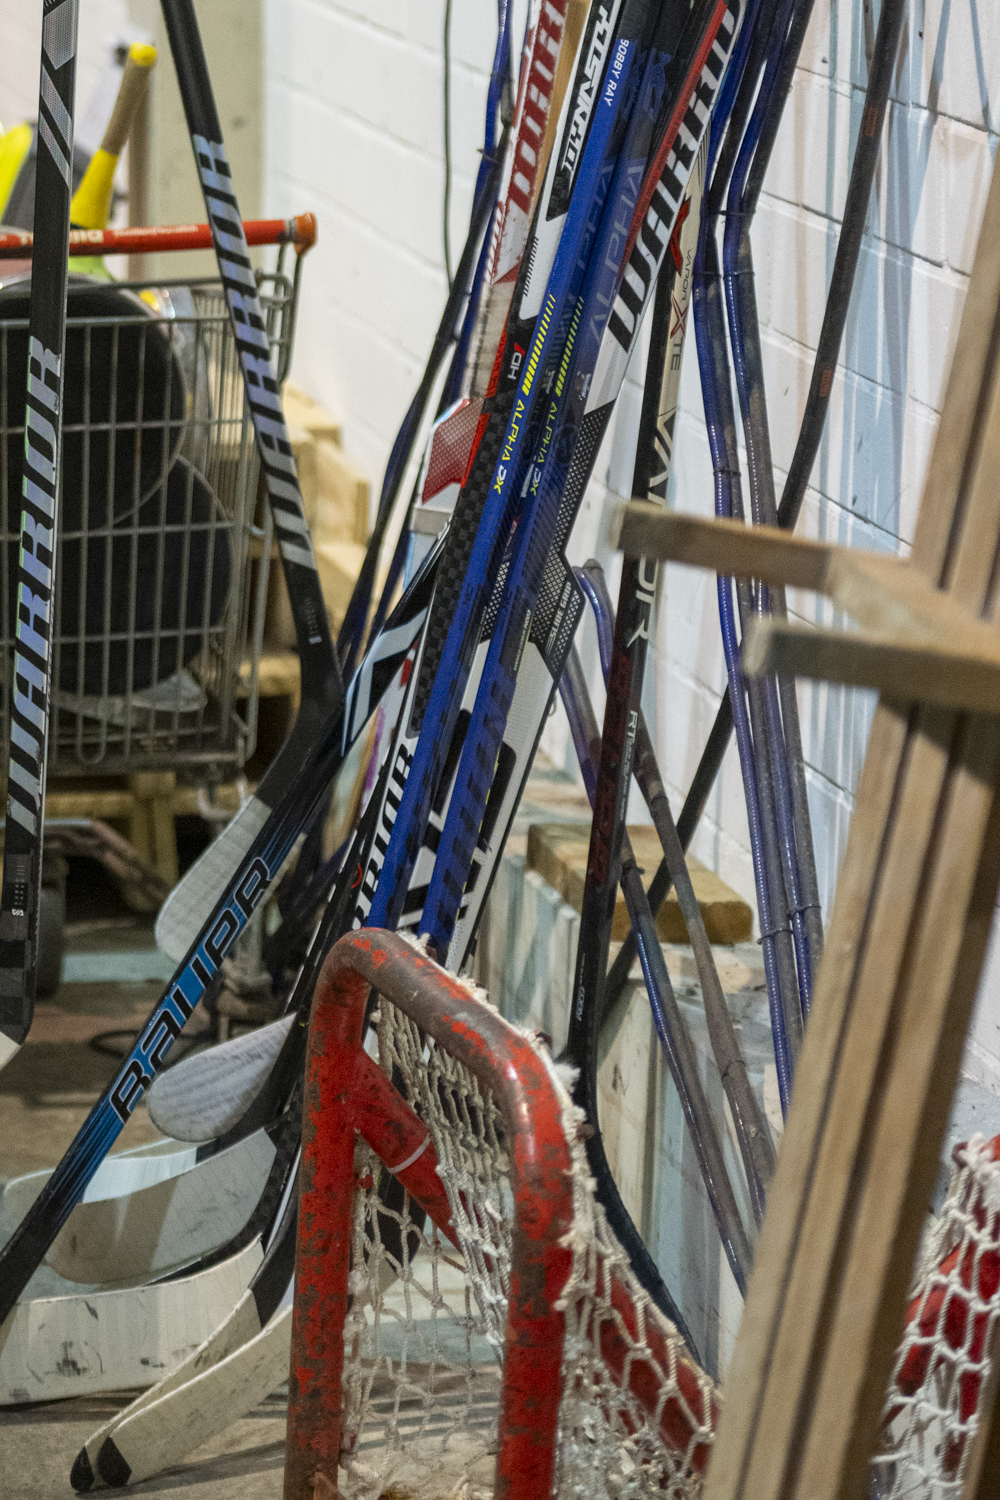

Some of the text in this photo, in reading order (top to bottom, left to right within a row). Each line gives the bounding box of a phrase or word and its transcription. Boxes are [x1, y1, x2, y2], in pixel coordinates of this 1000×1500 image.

[560, 3, 611, 172] DYNASTY
[605, 38, 630, 106] BOBBY RAY
[681, 248, 692, 302] VAPOR
[193, 133, 317, 570] WARRIOR
[502, 399, 525, 461] ALPHA
[538, 401, 558, 464] ALPHA
[7, 335, 61, 837] WARRIOR
[550, 581, 572, 638] SLIDE GRIP
[109, 857, 272, 1125] BAUER
